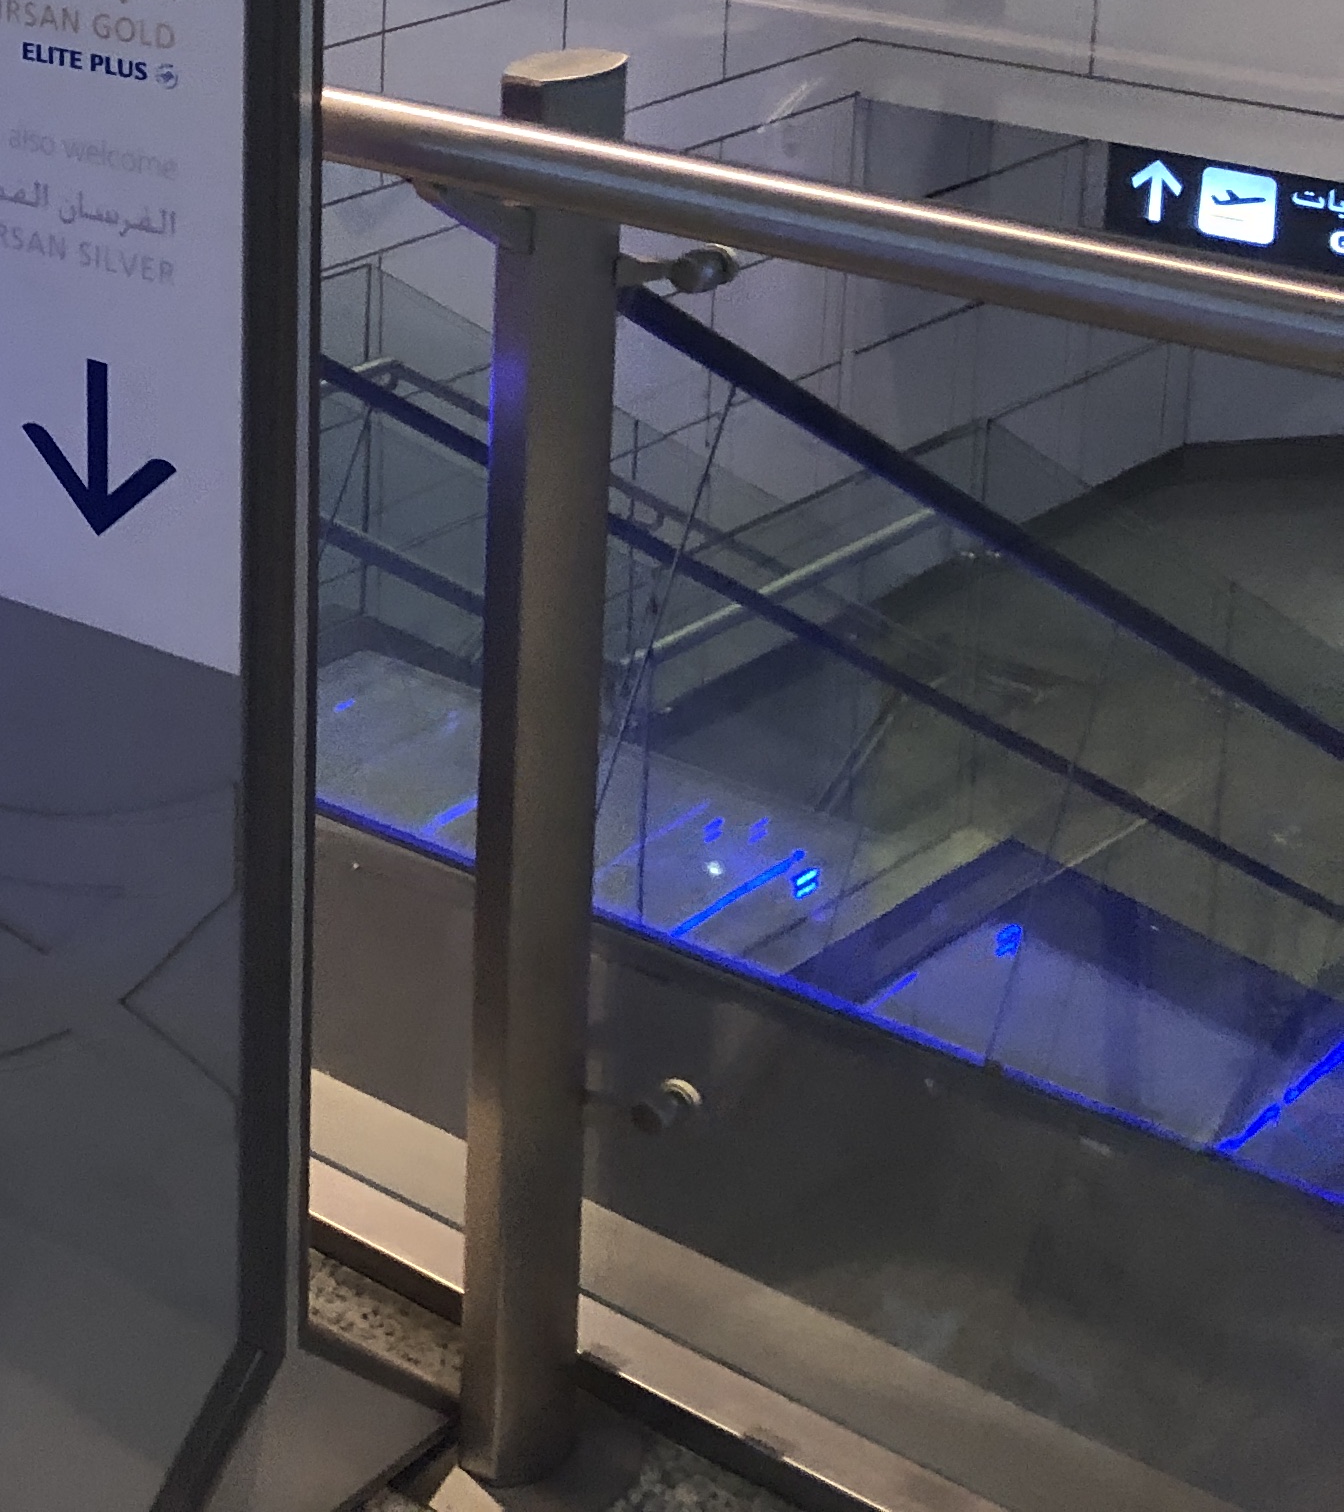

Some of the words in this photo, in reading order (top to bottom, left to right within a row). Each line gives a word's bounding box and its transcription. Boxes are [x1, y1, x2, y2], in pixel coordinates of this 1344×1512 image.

[92, 13, 176, 50] GOLD
[22, 41, 83, 70] ELITE
[90, 53, 148, 82] PLUS
[60, 140, 179, 181] welcome
[78, 241, 176, 286] SILVER
